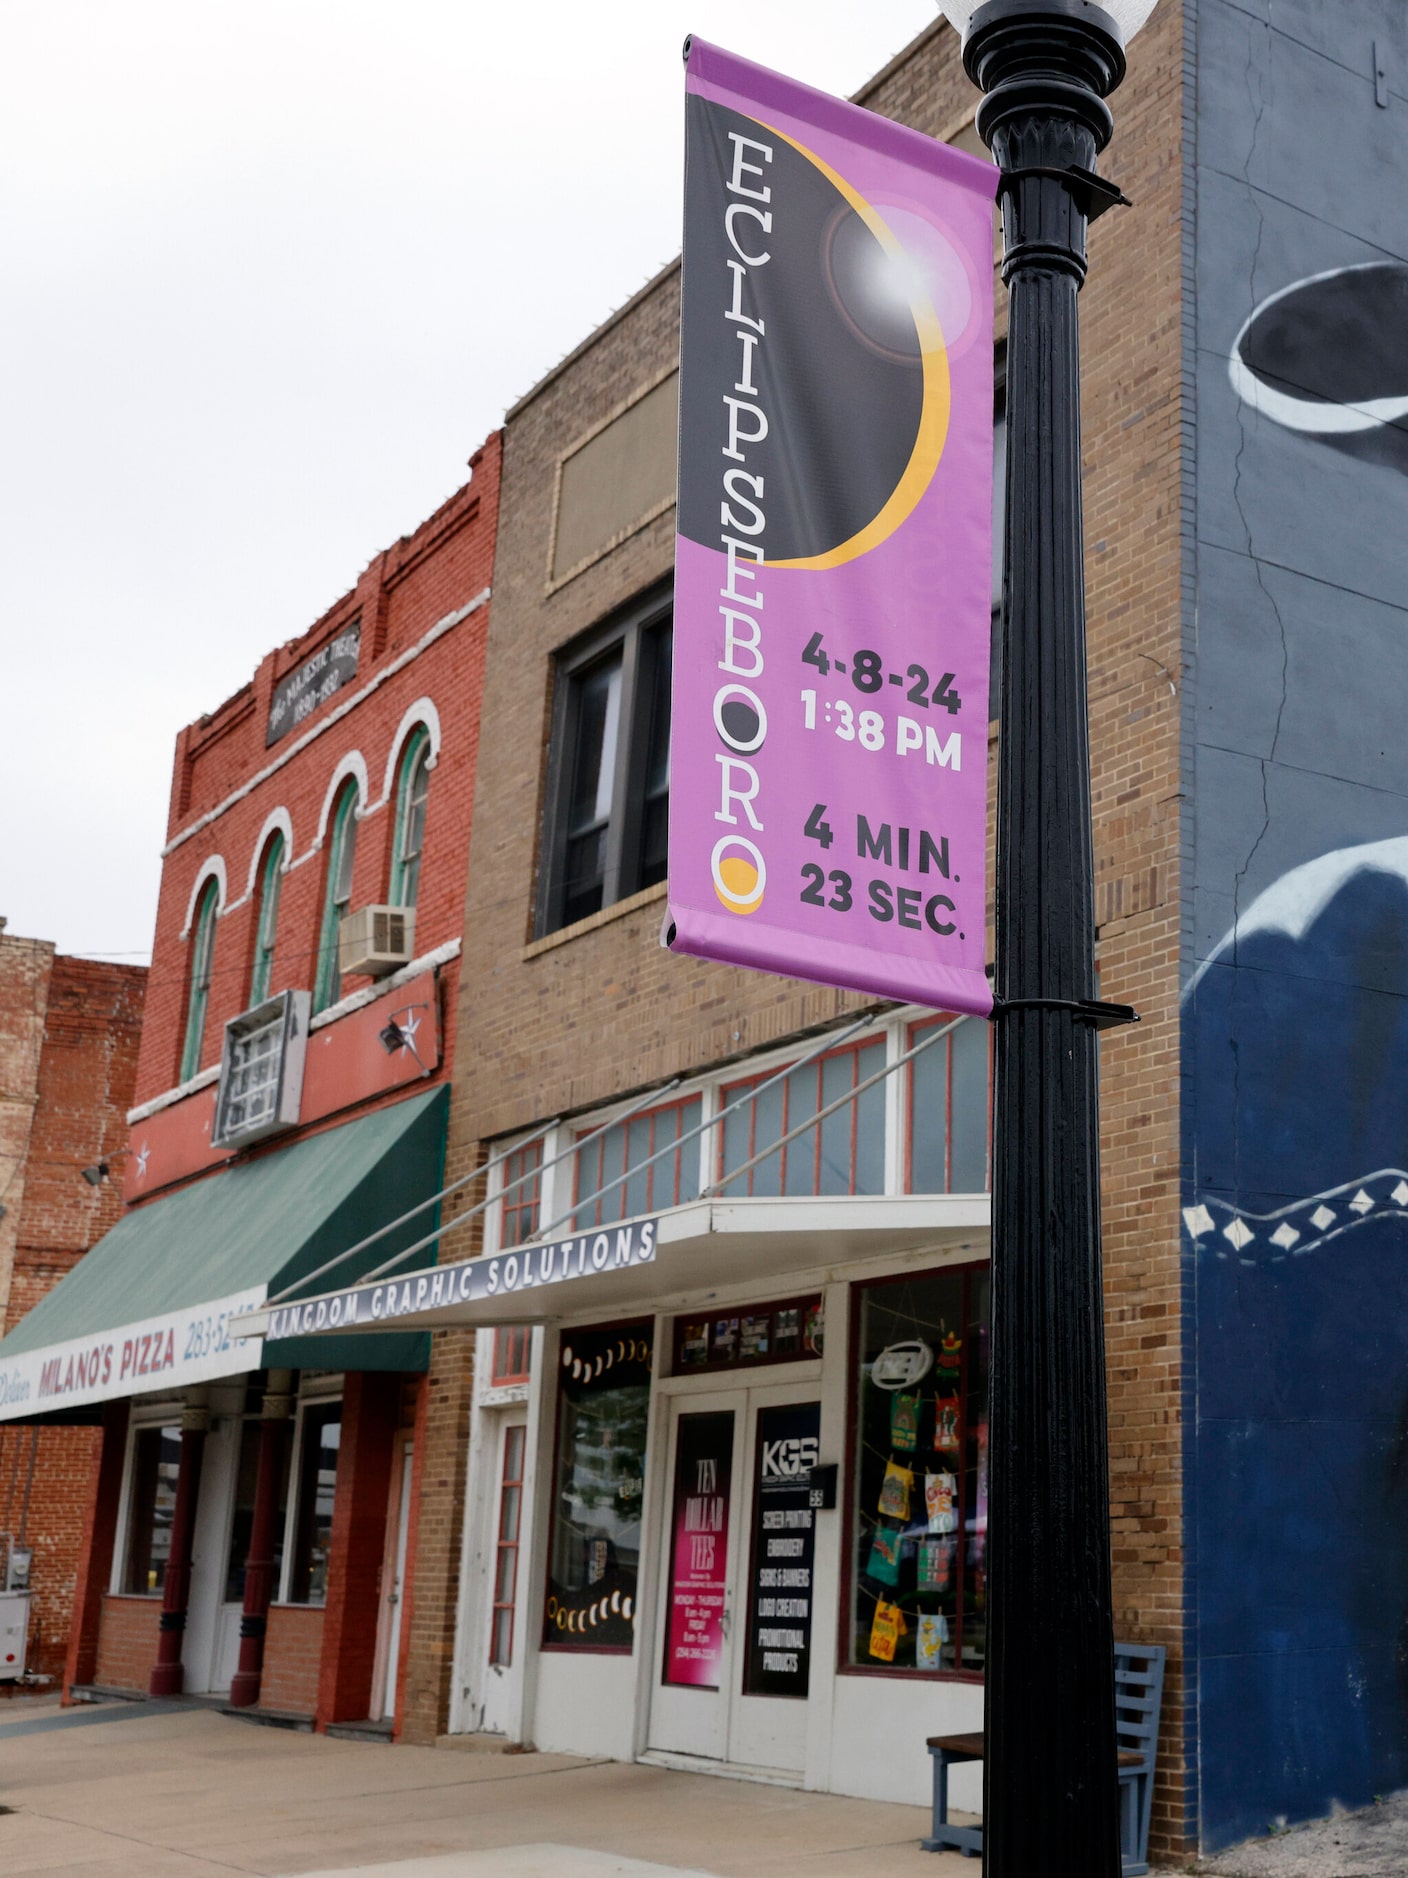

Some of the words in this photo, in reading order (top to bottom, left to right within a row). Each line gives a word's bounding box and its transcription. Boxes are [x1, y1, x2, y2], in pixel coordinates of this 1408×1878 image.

[710, 132, 773, 907] ECLIPSEBORO
[286, 646, 330, 706] MAJESTIC
[801, 632, 962, 715] 4-8-24
[800, 689, 885, 753] 1:38
[896, 717, 962, 772] PM
[803, 804, 834, 849] 4
[857, 815, 961, 882] MIN.
[800, 863, 853, 913] 23
[868, 880, 966, 940] SEC.
[267, 1296, 358, 1340] KINGDOM
[371, 1267, 472, 1319] GRAPHIC
[487, 1222, 655, 1294] SOLUTIONS
[38, 1344, 114, 1399] MILANO'S
[120, 1328, 175, 1381] PIZZA
[696, 1458, 718, 1494] TEN
[761, 1437, 819, 1476] KGS
[690, 1535, 715, 1570] TEES
[758, 1598, 775, 1617] LOGO
[762, 1652, 798, 1673] PRODUCTS
